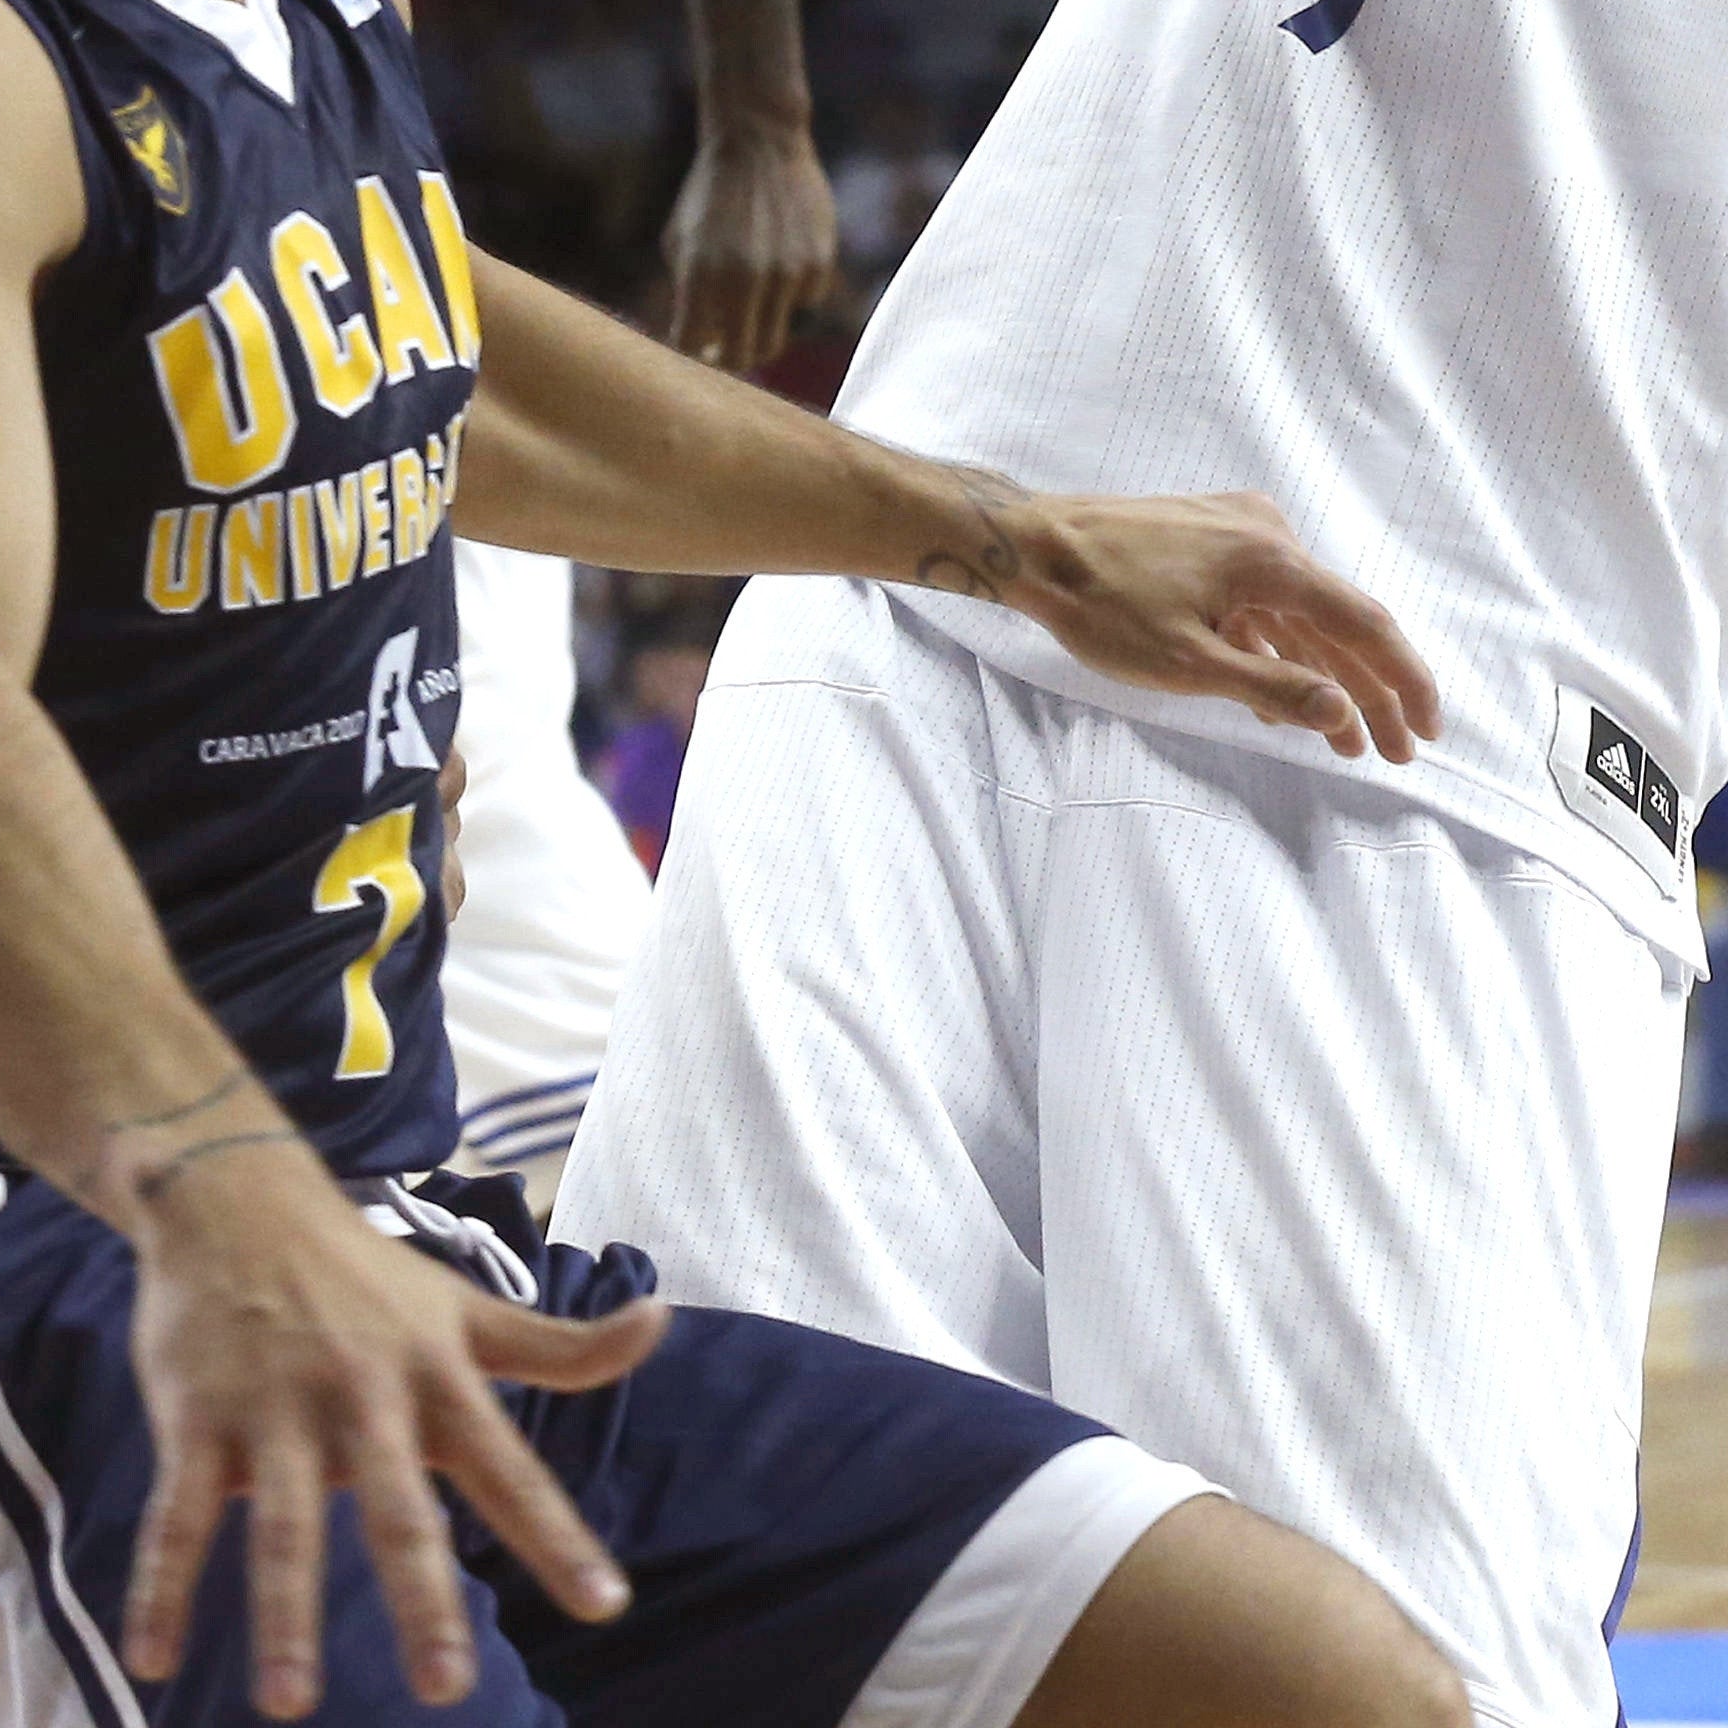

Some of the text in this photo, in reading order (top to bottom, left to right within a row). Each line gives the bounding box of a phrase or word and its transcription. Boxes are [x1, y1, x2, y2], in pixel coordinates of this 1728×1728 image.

[1596, 755, 1637, 796] adidas
[1649, 784, 1672, 825] 2XL
[311, 803, 427, 1080] 7
